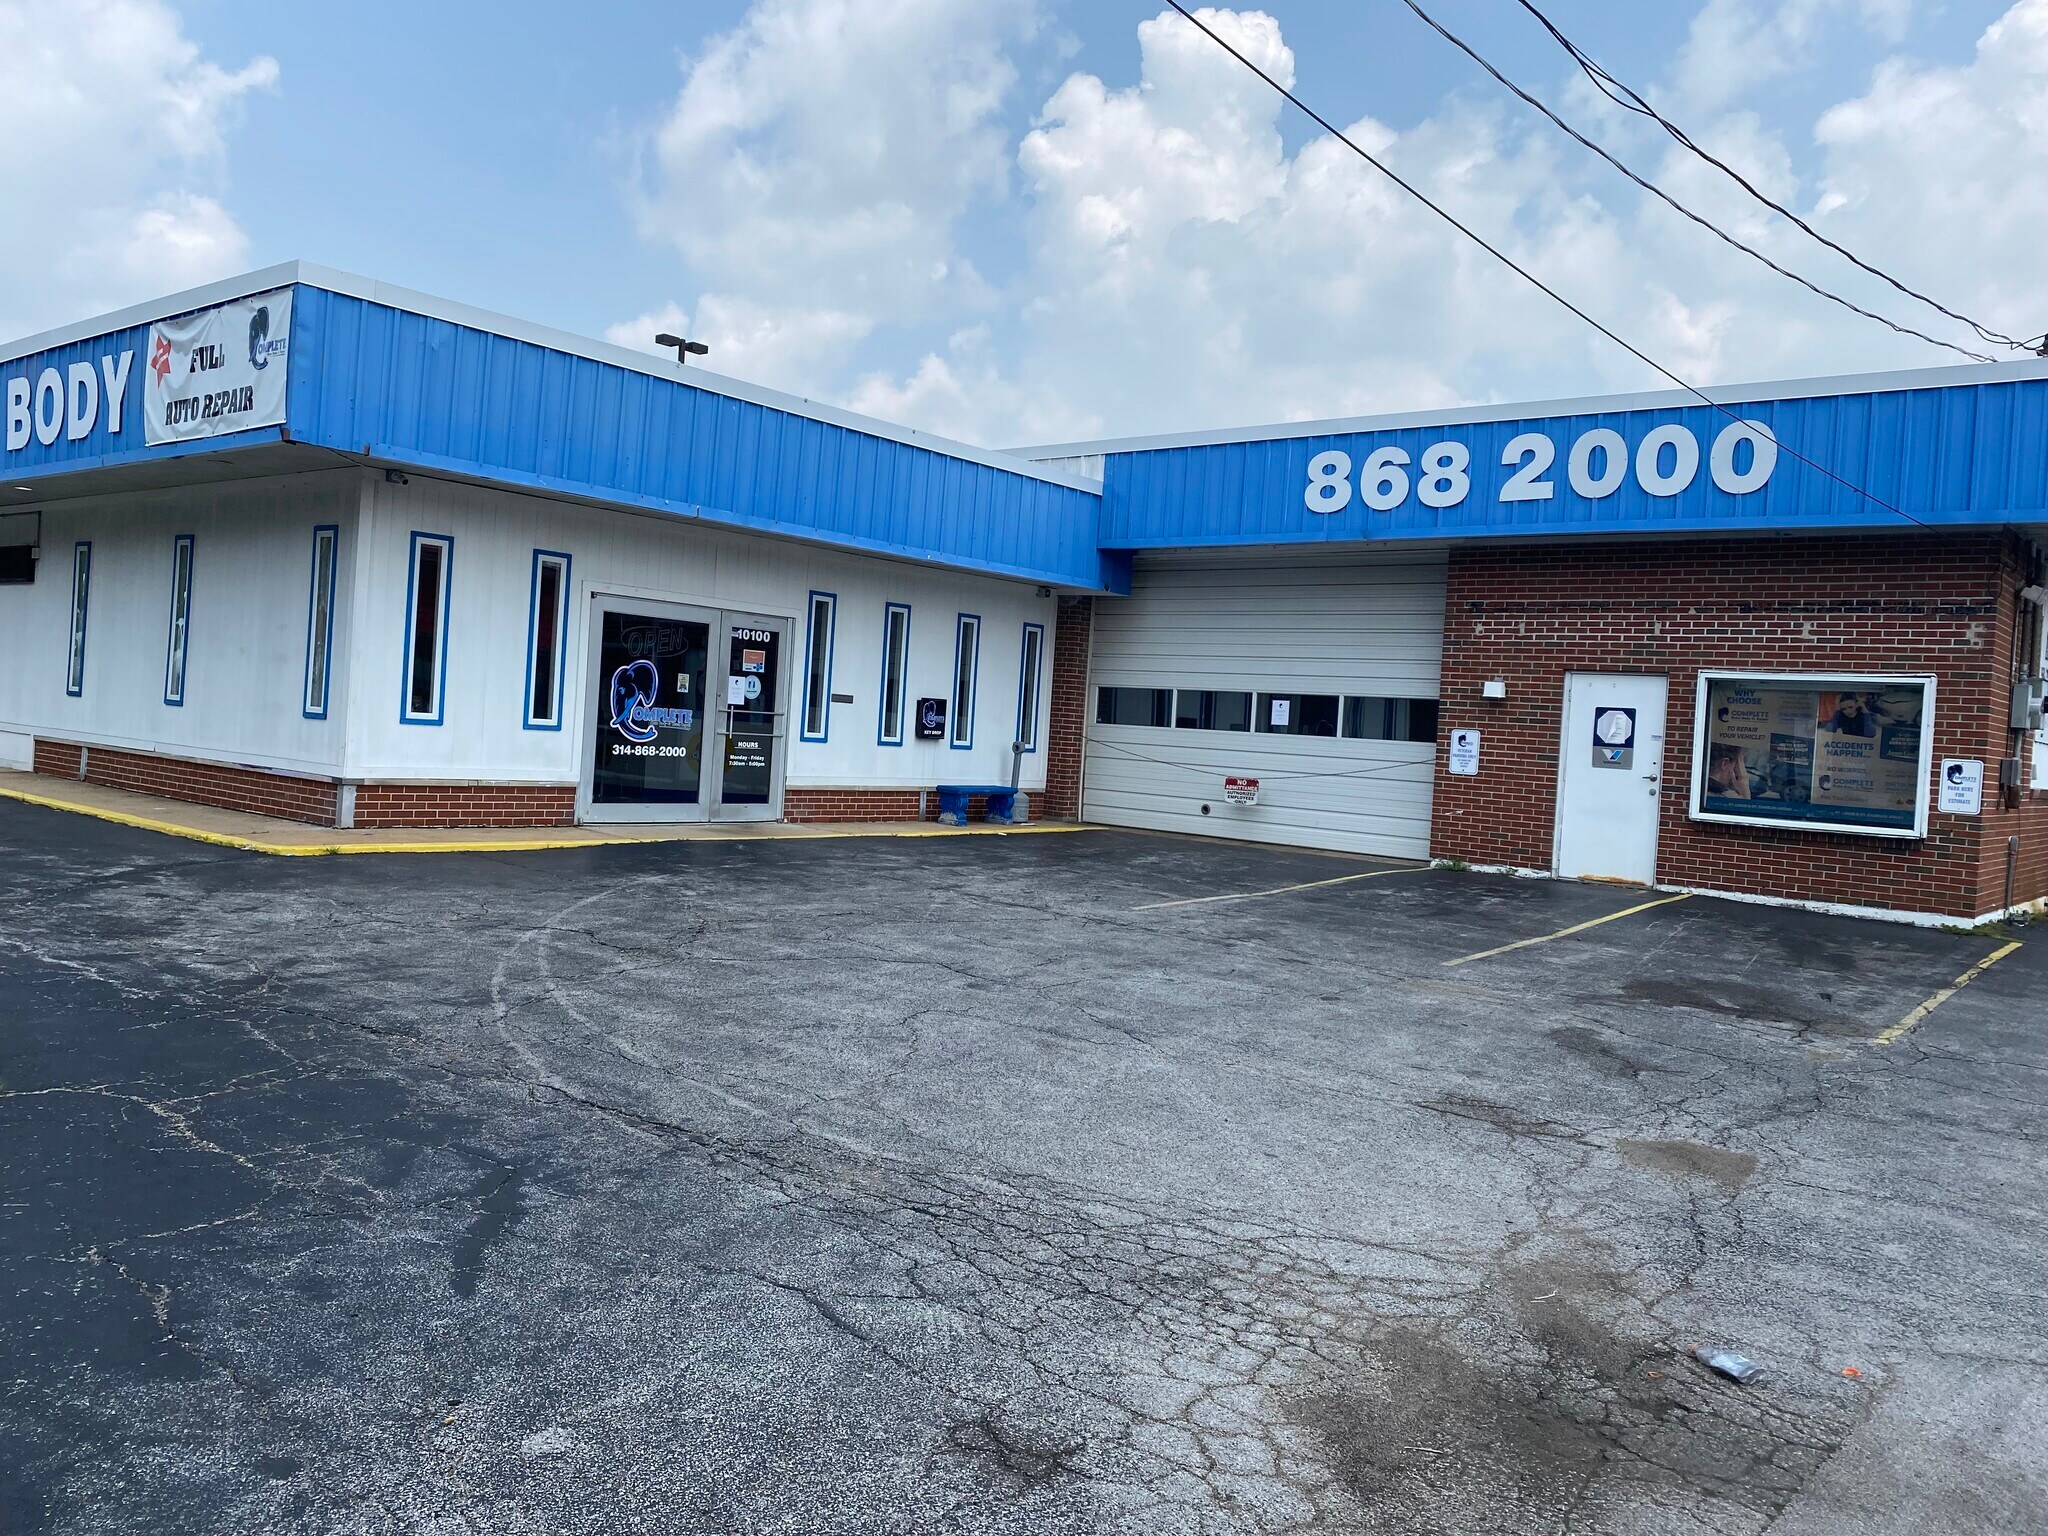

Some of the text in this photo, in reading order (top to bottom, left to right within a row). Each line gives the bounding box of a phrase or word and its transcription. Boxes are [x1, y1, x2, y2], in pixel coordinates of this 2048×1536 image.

[190, 343, 225, 373] FULL
[7, 350, 134, 451] BODY
[165, 385, 254, 426] AUTO REPAIR
[1304, 419, 1778, 514] 868 2000
[628, 628, 683, 656] OPEN
[738, 629, 770, 642] 10100
[1727, 697, 1762, 705] CHOOSE
[1734, 689, 1756, 697] WHY
[1731, 710, 1769, 718] COMPLETE
[1824, 741, 1874, 751] ACCIDENTS
